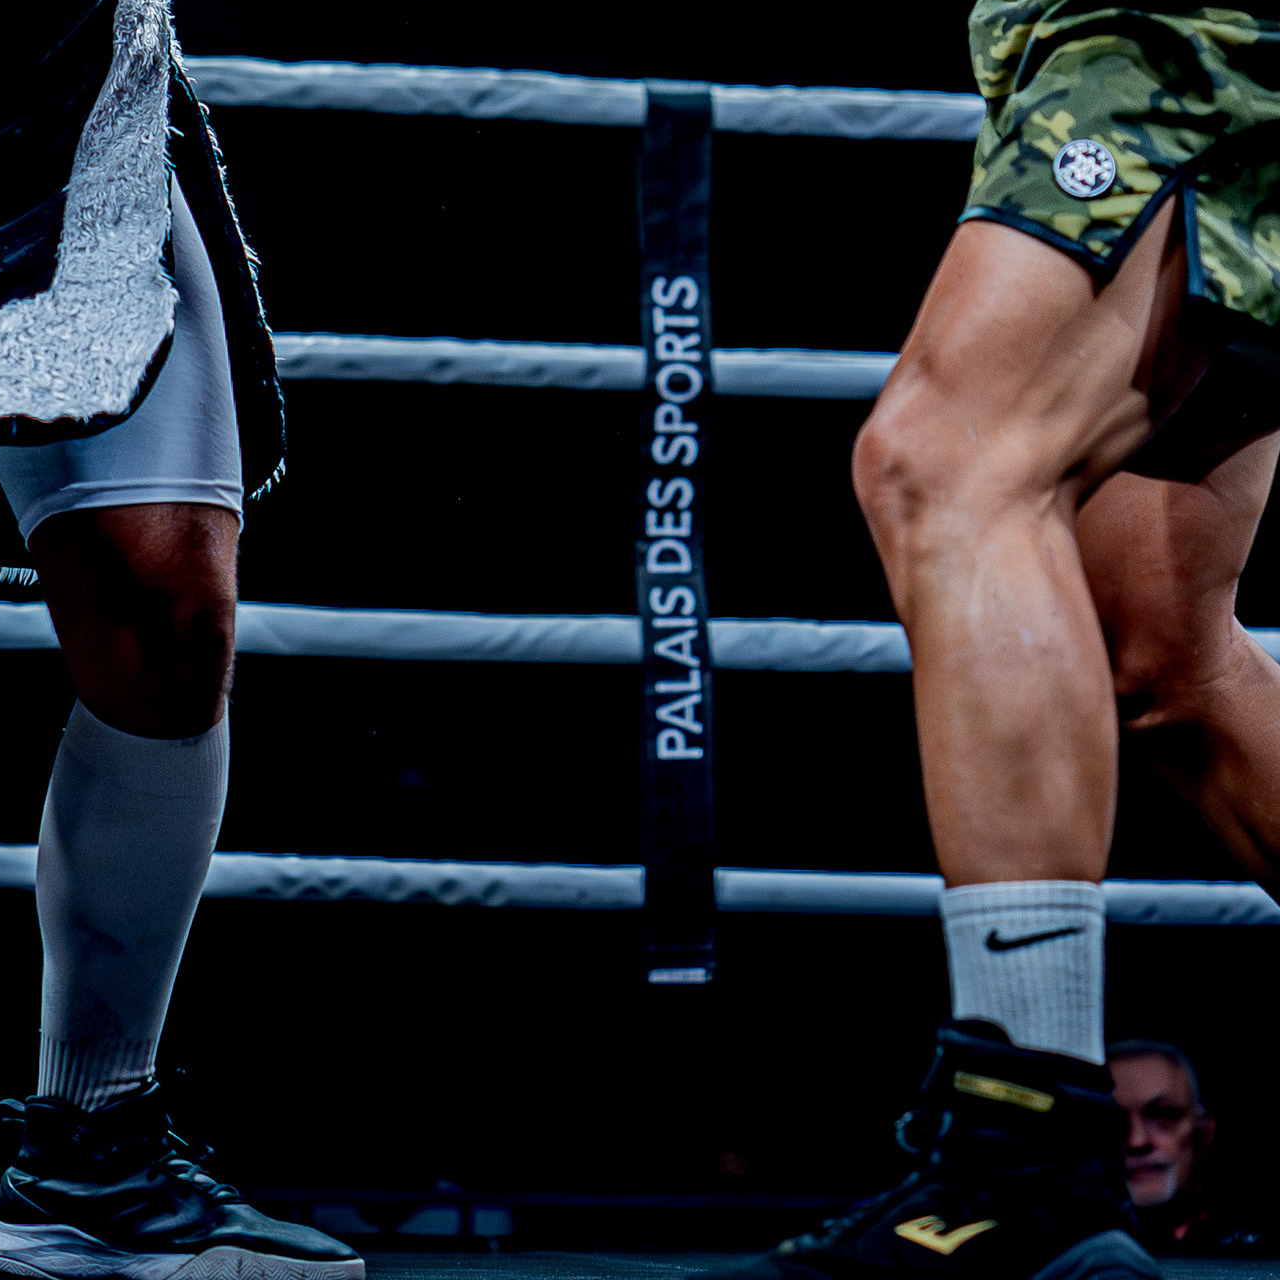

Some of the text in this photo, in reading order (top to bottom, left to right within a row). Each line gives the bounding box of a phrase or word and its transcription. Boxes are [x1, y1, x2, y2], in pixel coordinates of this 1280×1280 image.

[645, 275, 704, 760] PALAIS DES SPORTS
